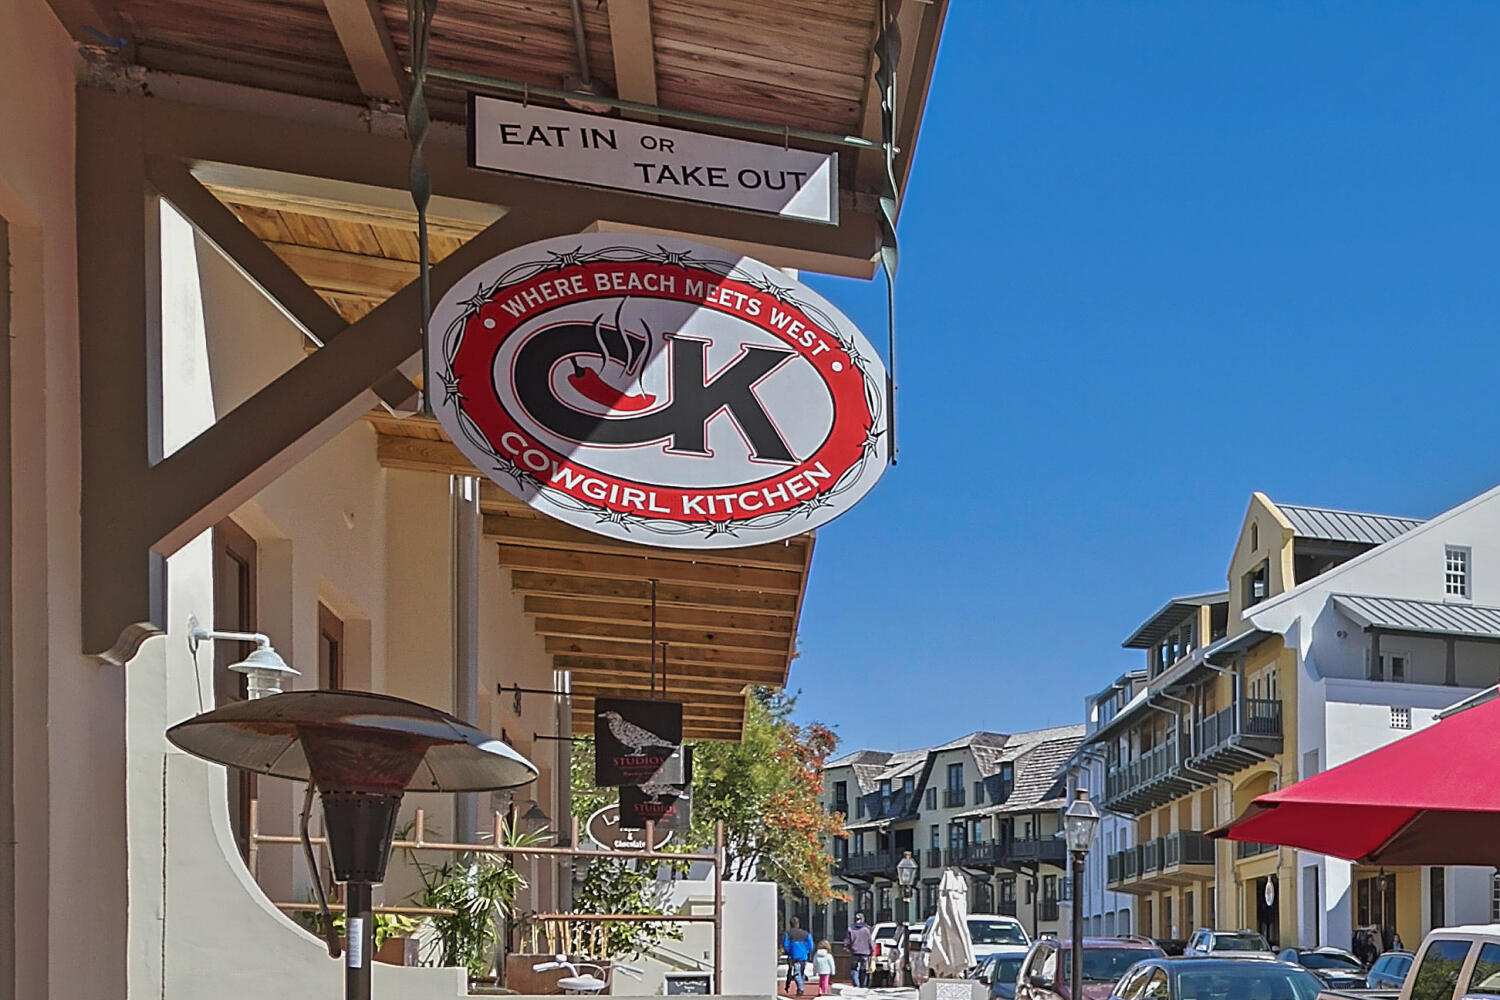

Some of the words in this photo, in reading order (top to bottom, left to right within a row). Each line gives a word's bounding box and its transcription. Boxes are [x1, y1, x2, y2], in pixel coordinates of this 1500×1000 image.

[499, 123, 570, 149] EAT
[580, 128, 619, 151] IN
[639, 135, 676, 154] OR
[633, 162, 729, 190] TAKE
[737, 167, 808, 192] OUT
[500, 274, 588, 319] WHERE
[594, 271, 676, 294] BEACH
[684, 278, 761, 317] MEETS
[769, 307, 831, 357] WEST
[500, 430, 671, 514] COWGIRL
[682, 461, 832, 516] KITCHEN
